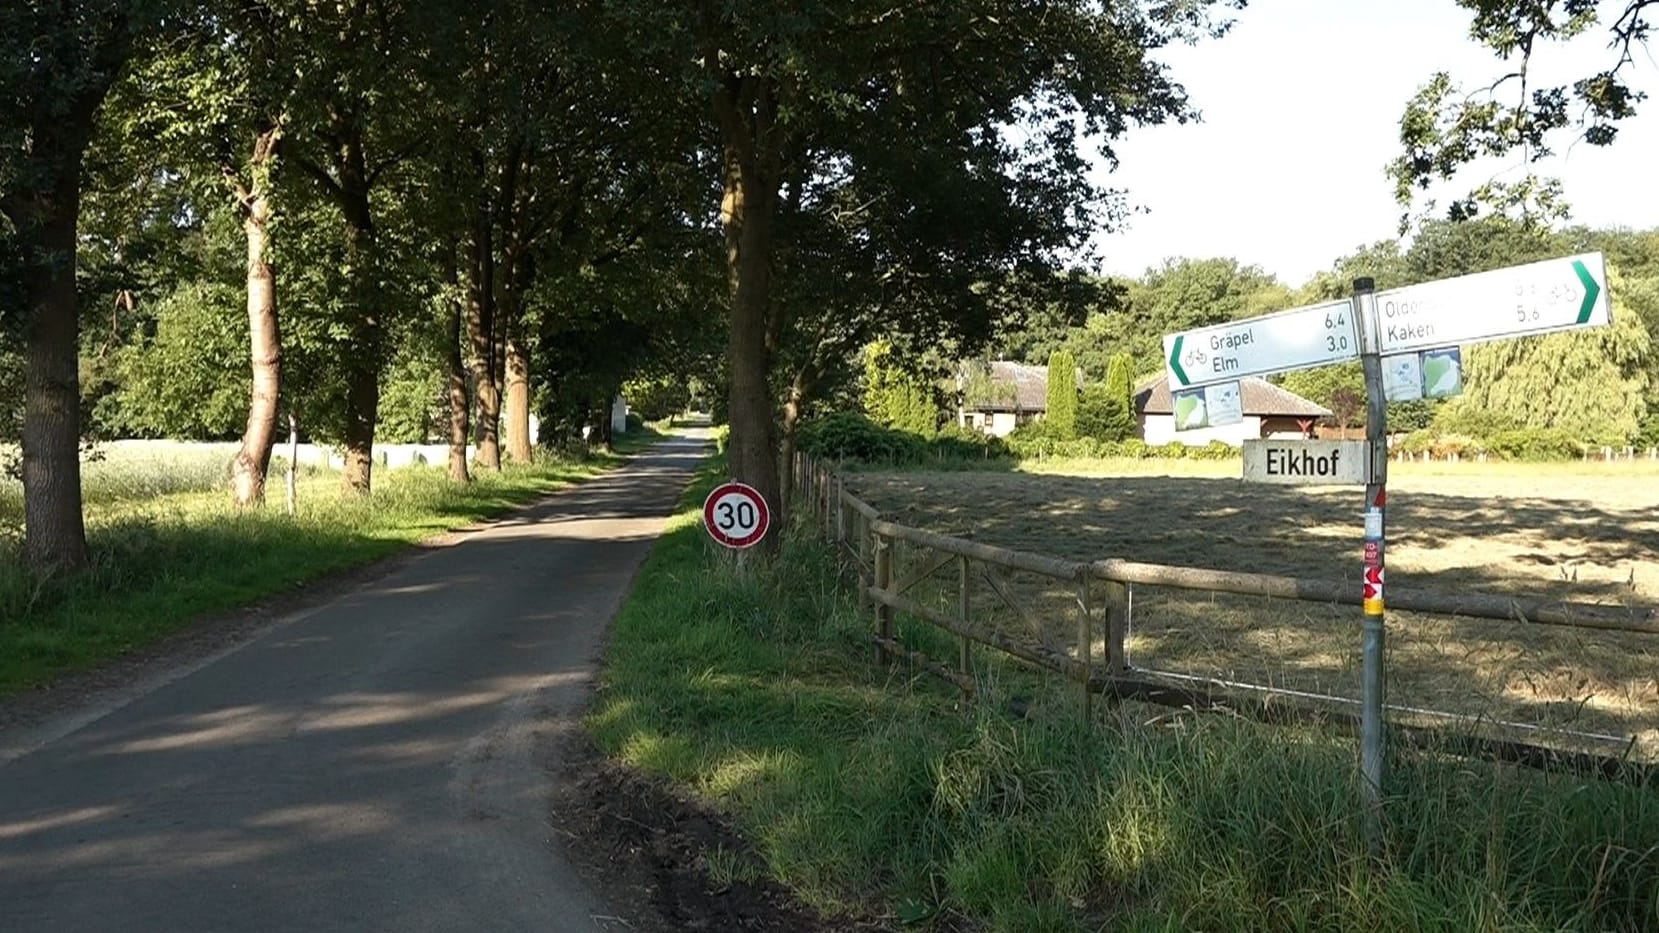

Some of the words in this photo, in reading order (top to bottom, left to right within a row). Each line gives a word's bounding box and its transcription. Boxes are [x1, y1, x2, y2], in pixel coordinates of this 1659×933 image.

[1210, 328, 1255, 351] Gräpel
[1324, 312, 1346, 329] 6.4
[1387, 322, 1436, 343] Kaken
[1516, 304, 1541, 323] 5.6
[1212, 356, 1240, 373] Elm
[1326, 335, 1348, 352] 3.0
[1266, 448, 1340, 476] Eikhof
[717, 501, 755, 530] 30
